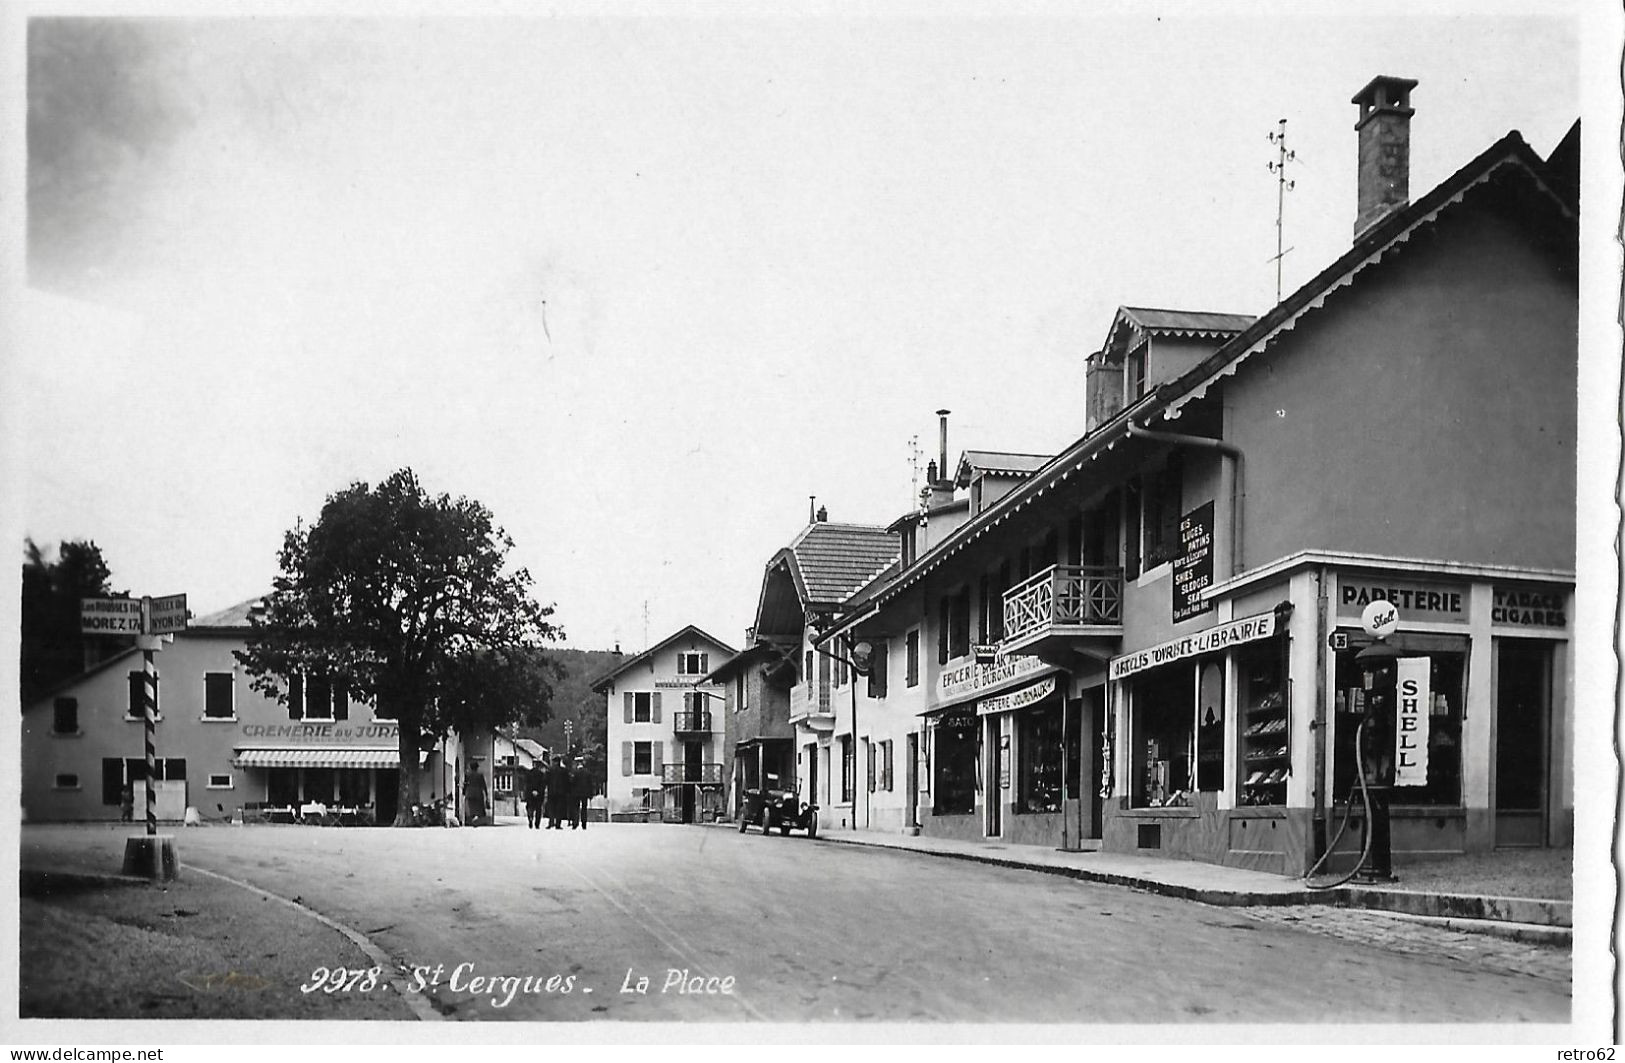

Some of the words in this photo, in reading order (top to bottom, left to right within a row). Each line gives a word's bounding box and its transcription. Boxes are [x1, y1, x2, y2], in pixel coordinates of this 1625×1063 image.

[1188, 533, 1211, 552] PATINS
[1181, 574, 1209, 595] SLEDGES
[1343, 586, 1462, 613] PAPETERIE
[82, 617, 126, 630] MOREZ
[152, 616, 174, 629] NYON
[1372, 609, 1395, 630] Shell
[1491, 607, 1567, 627] CIGARES
[1199, 618, 1269, 653] LIBRAIRIE
[943, 663, 980, 689] EPICERIE
[242, 726, 333, 738] CREMERIE
[355, 726, 401, 739] JURA
[1399, 679, 1418, 768] SHELL
